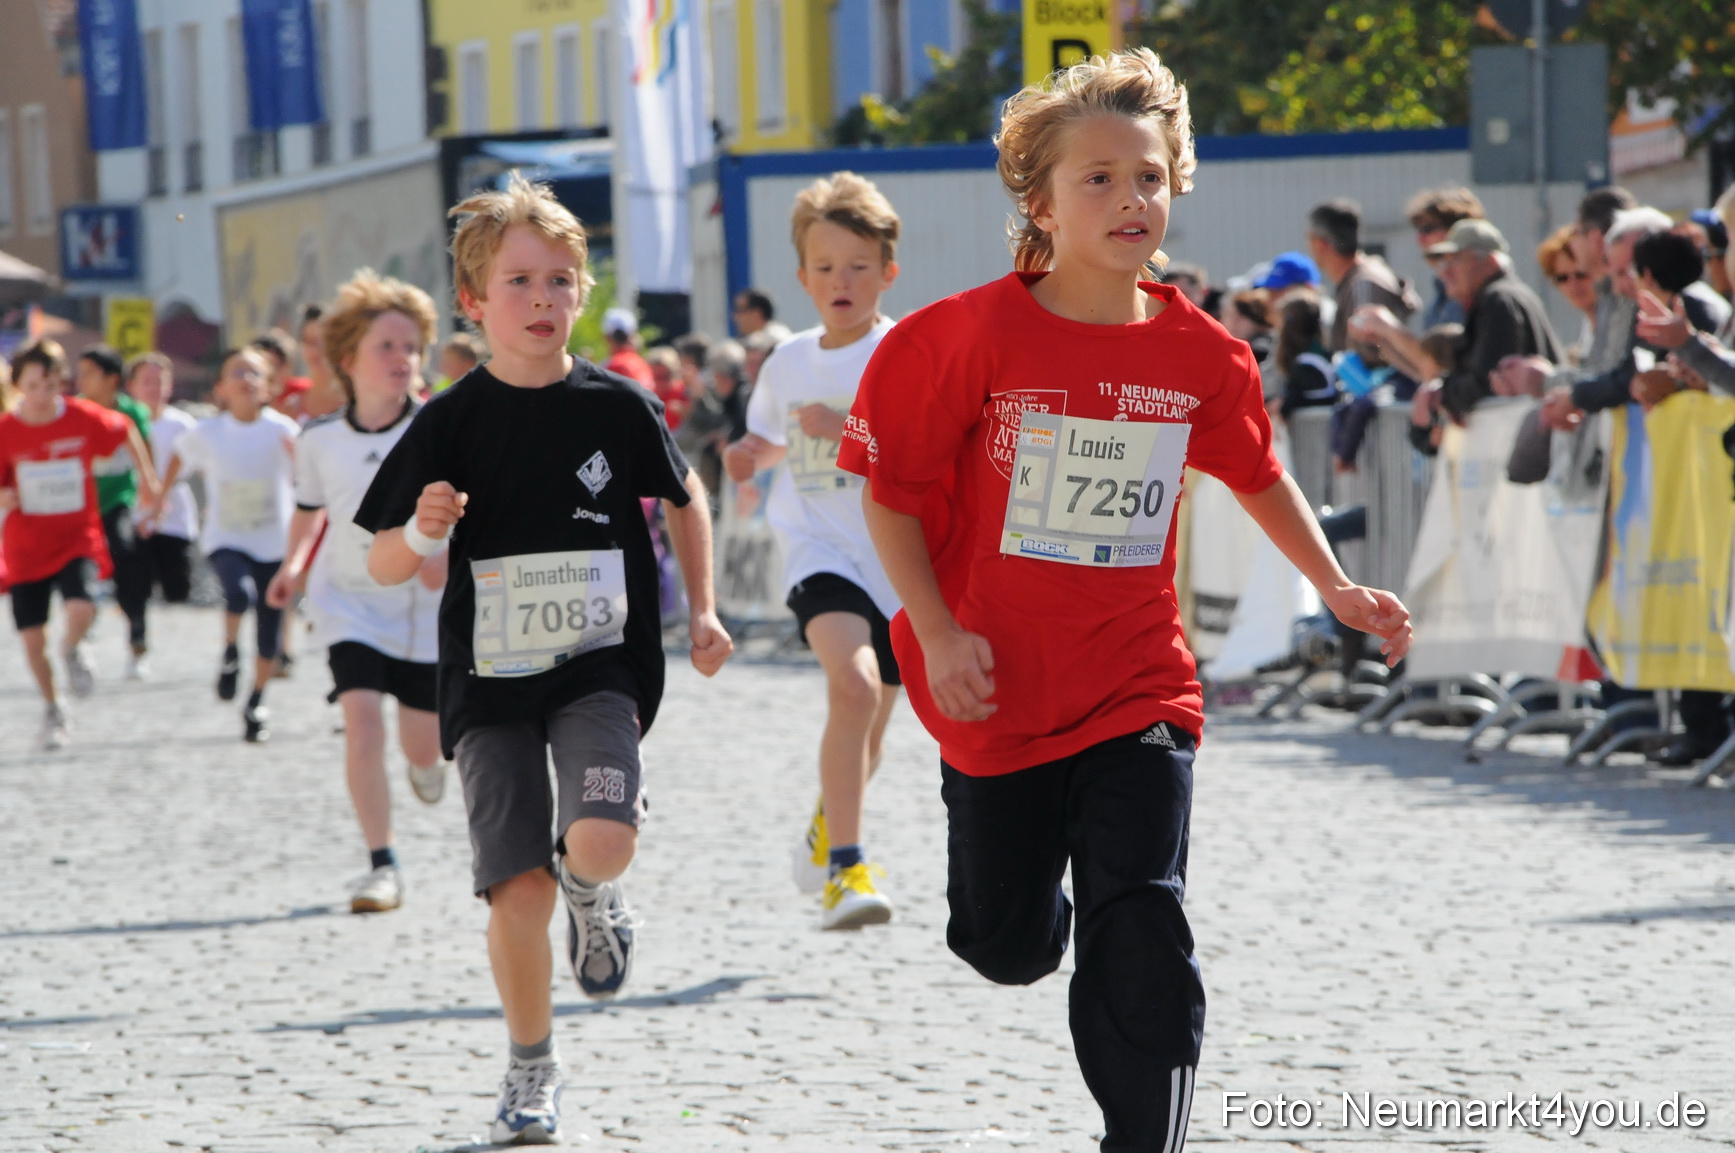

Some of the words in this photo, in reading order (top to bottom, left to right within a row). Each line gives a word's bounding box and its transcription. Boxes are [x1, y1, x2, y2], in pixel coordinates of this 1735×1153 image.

[1098, 382, 1118, 397] 11.
[994, 400, 1050, 414] IMMER
[1068, 429, 1125, 460] Louis
[1020, 466, 1032, 487] K
[1066, 475, 1165, 518] 7250
[1021, 539, 1068, 554] BOCK
[1112, 543, 1161, 557] PFLEIDERER
[513, 562, 600, 589] Jonathan
[482, 605, 491, 622] K
[518, 596, 613, 635] 7083
[1140, 735, 1177, 750] adidas
[583, 775, 625, 804] 28
